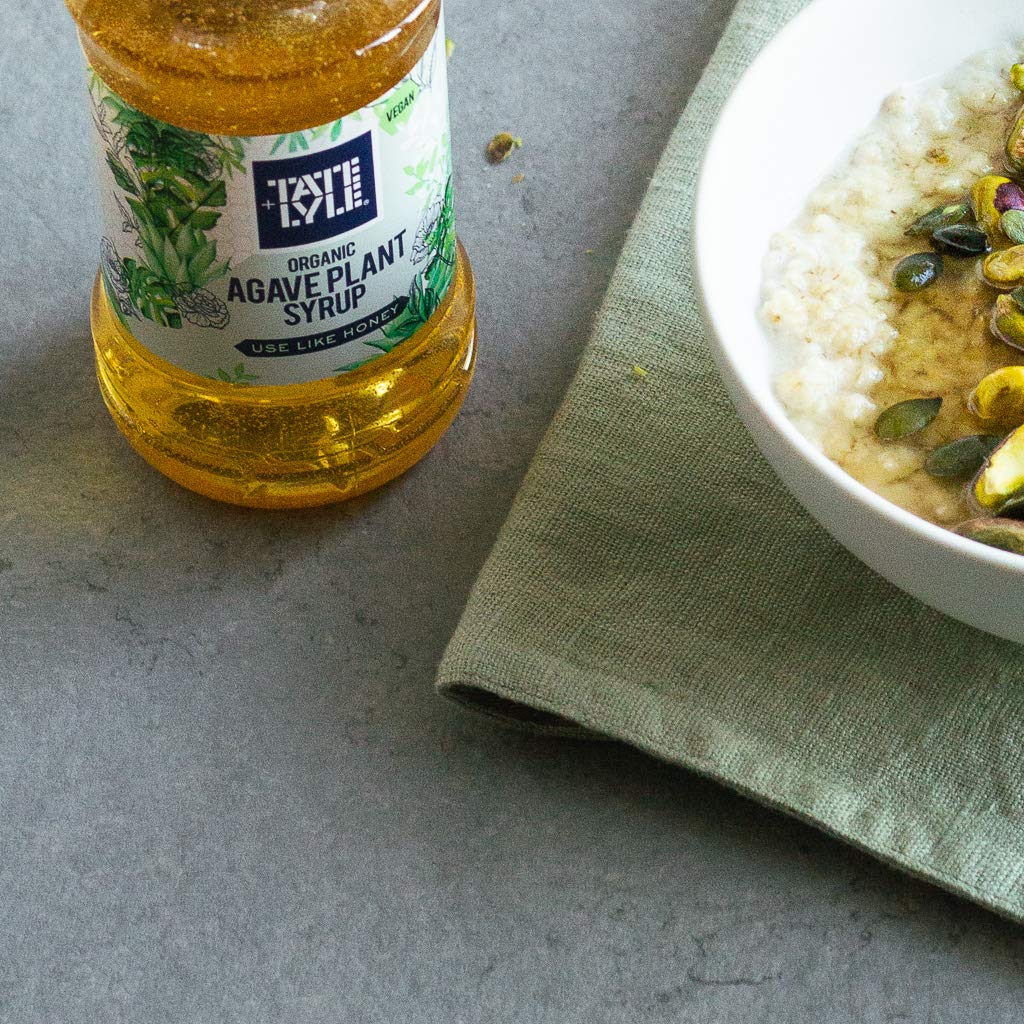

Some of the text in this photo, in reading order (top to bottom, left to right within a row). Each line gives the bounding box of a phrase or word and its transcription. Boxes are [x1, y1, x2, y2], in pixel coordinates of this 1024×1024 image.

[386, 90, 415, 122] VEGAN
[267, 157, 360, 203] TATE
[280, 184, 363, 229] LYLE
[227, 228, 407, 305] AGAVE PLANT
[287, 241, 356, 273] ORGANIC
[283, 283, 366, 326] SYRUP
[251, 302, 399, 353] USE LIKE HONEY
